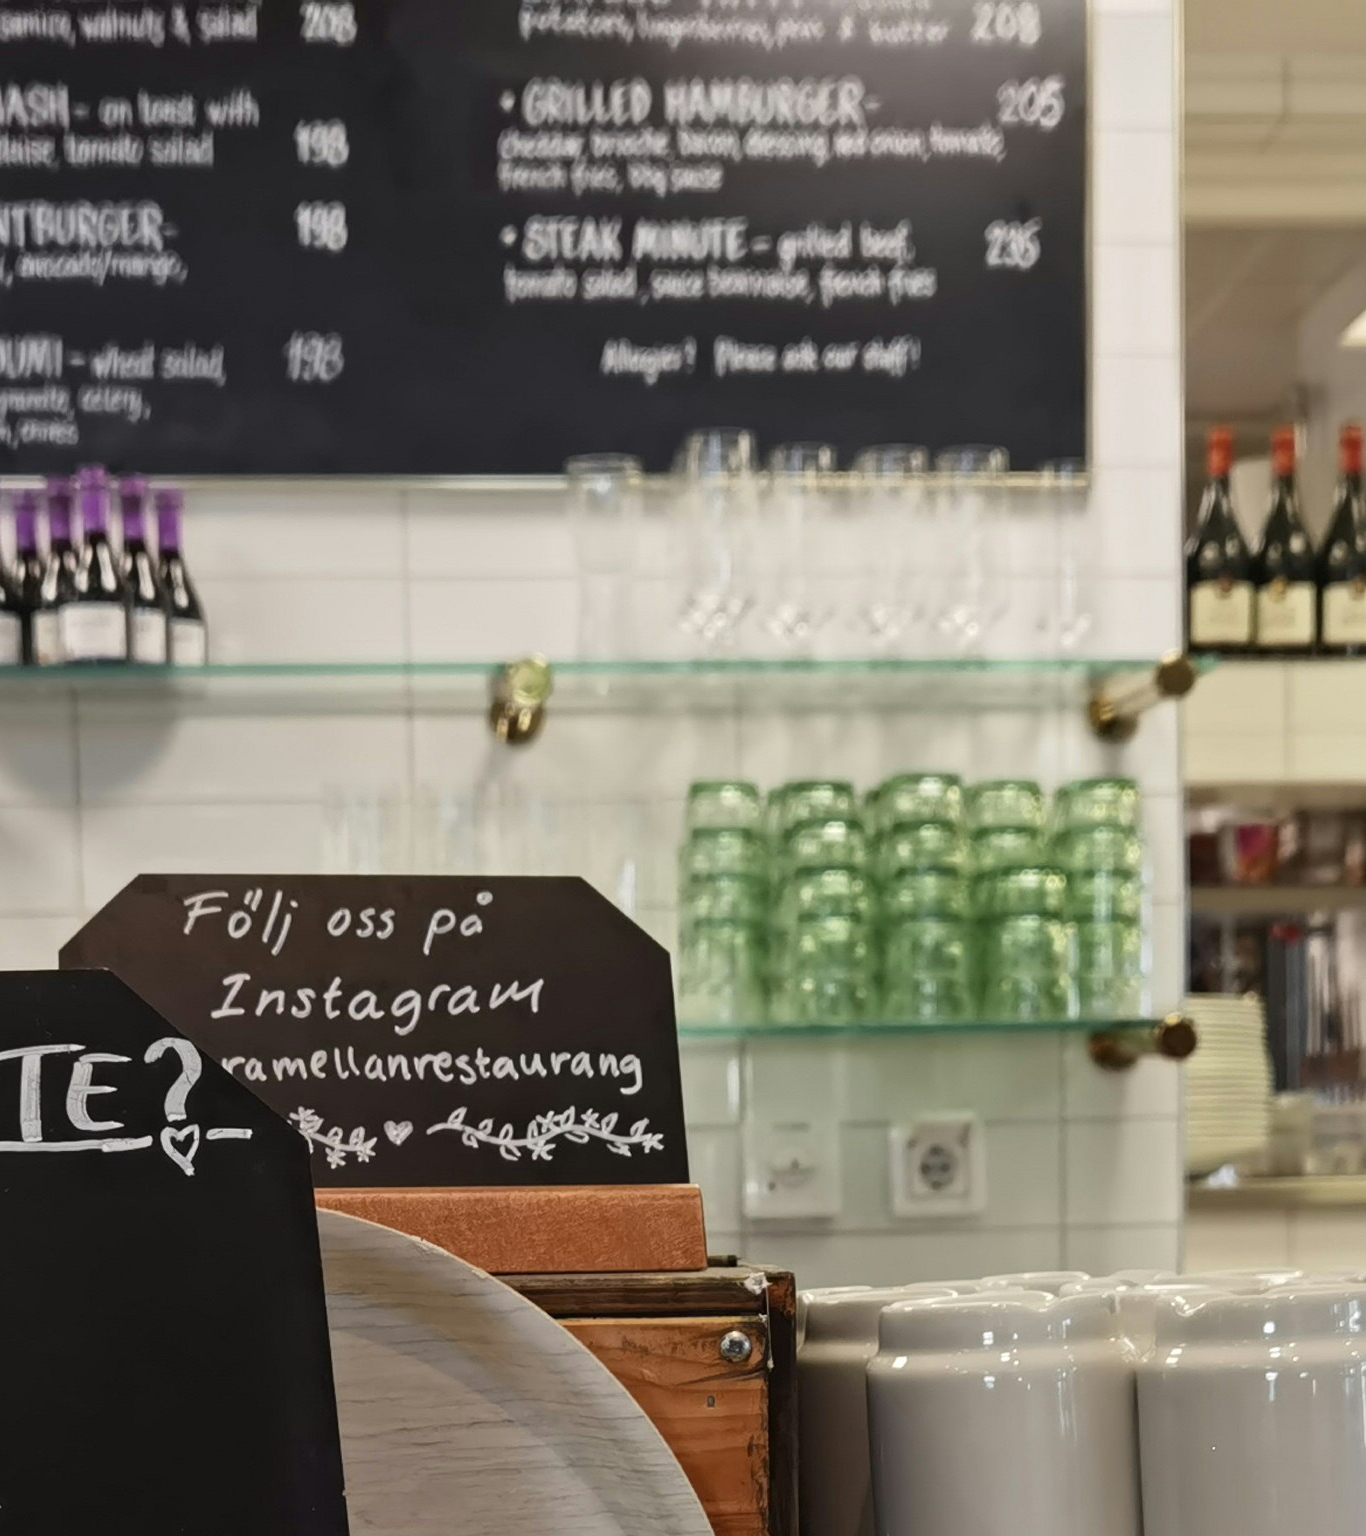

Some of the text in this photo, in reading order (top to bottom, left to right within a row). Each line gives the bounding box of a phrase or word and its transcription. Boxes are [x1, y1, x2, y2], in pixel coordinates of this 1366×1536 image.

[204, 88, 260, 127] with
[522, 76, 652, 126] GRILLED
[522, 215, 622, 261] STEAK
[632, 217, 747, 261] MINUTE
[183, 888, 493, 957] Följ oss på
[211, 973, 544, 1036] Instagram
